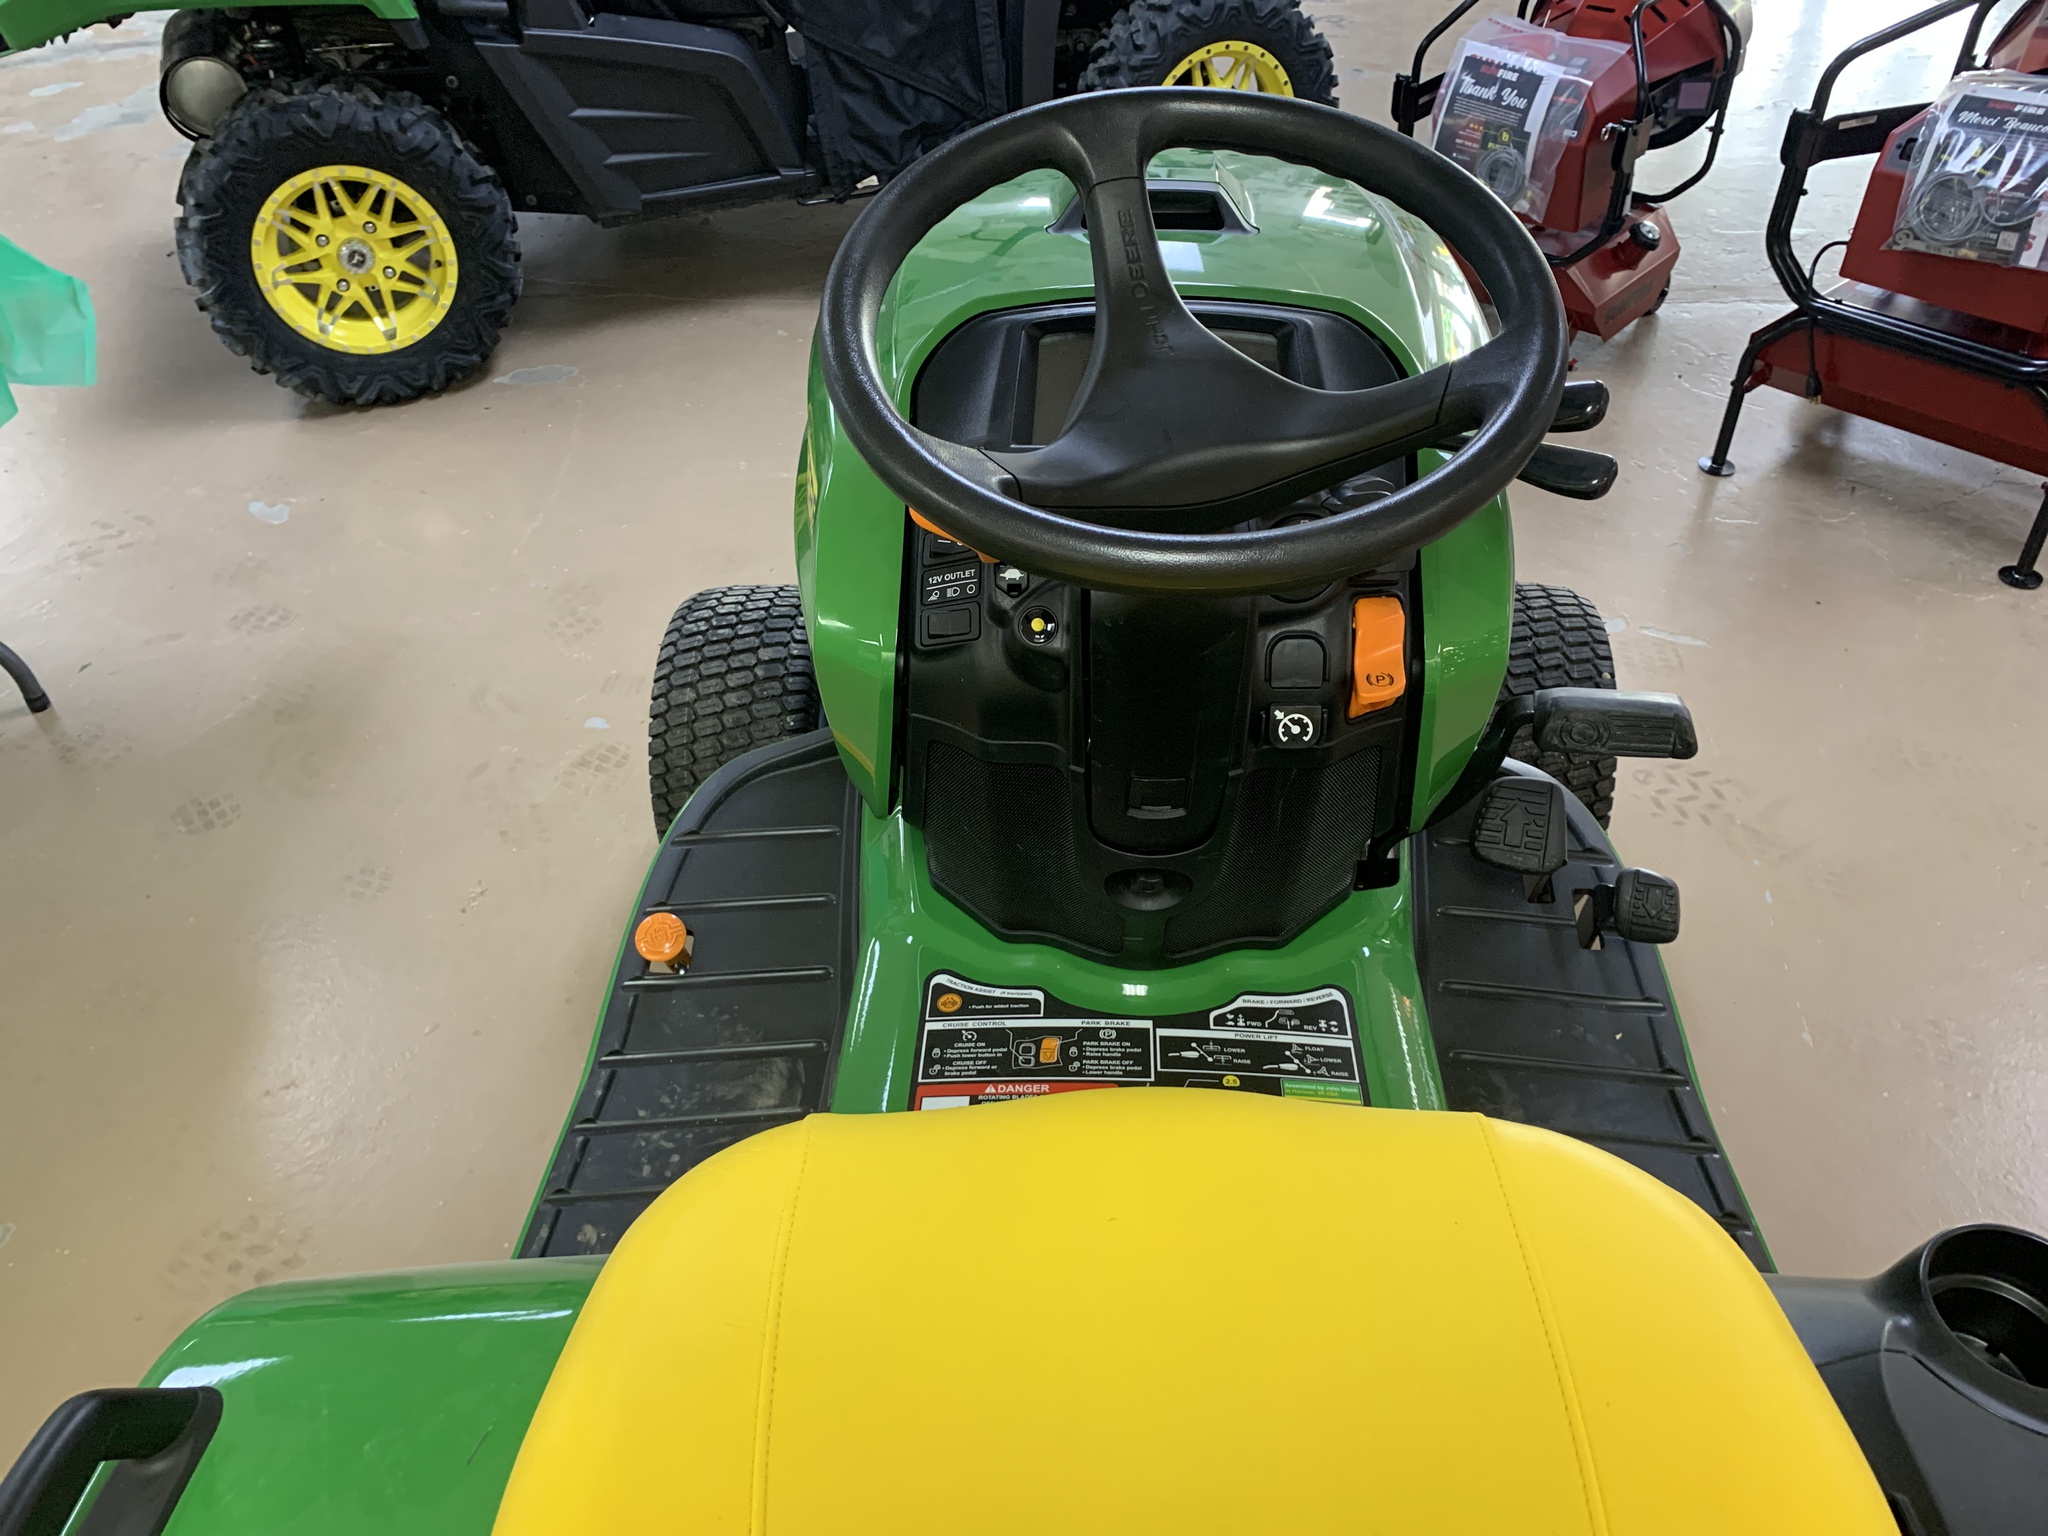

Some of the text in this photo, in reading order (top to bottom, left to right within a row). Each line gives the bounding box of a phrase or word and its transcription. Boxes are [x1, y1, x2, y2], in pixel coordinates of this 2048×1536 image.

[1459, 71, 1528, 109] Thank You
[1957, 110, 2001, 126] Merci
[1117, 208, 1148, 298] DEERE
[928, 569, 976, 584] 12V OUTLET
[946, 978, 974, 991] TRACTION
[974, 986, 996, 994] ASSIST
[1306, 992, 1334, 1003] REVERSE
[997, 1084, 1050, 1093] DANGER
